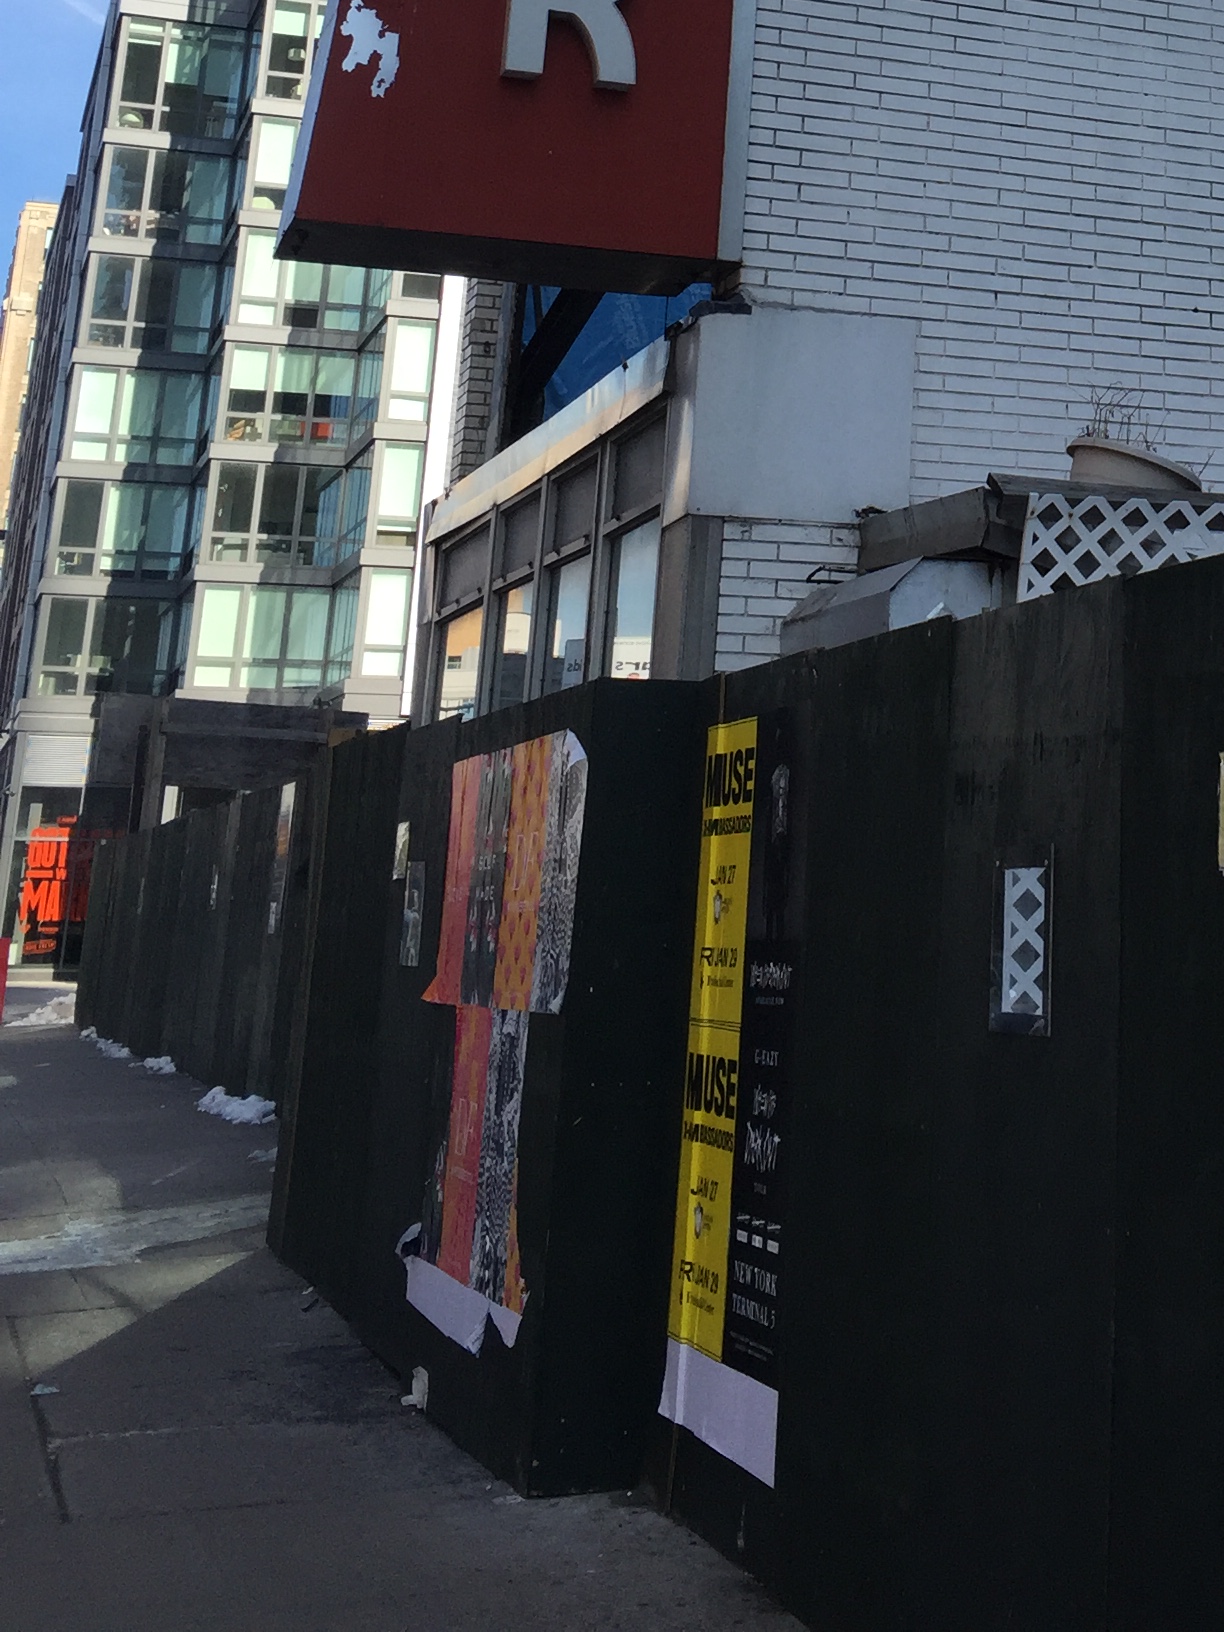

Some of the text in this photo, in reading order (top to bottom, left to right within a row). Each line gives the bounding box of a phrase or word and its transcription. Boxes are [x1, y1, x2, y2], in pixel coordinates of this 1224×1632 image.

[703, 746, 756, 809] MUSE
[685, 1051, 737, 1120] MUSE
[733, 1259, 778, 1297] NEW YORK
[731, 1292, 769, 1328] TERMINAL
[769, 1309, 776, 1331] 5
